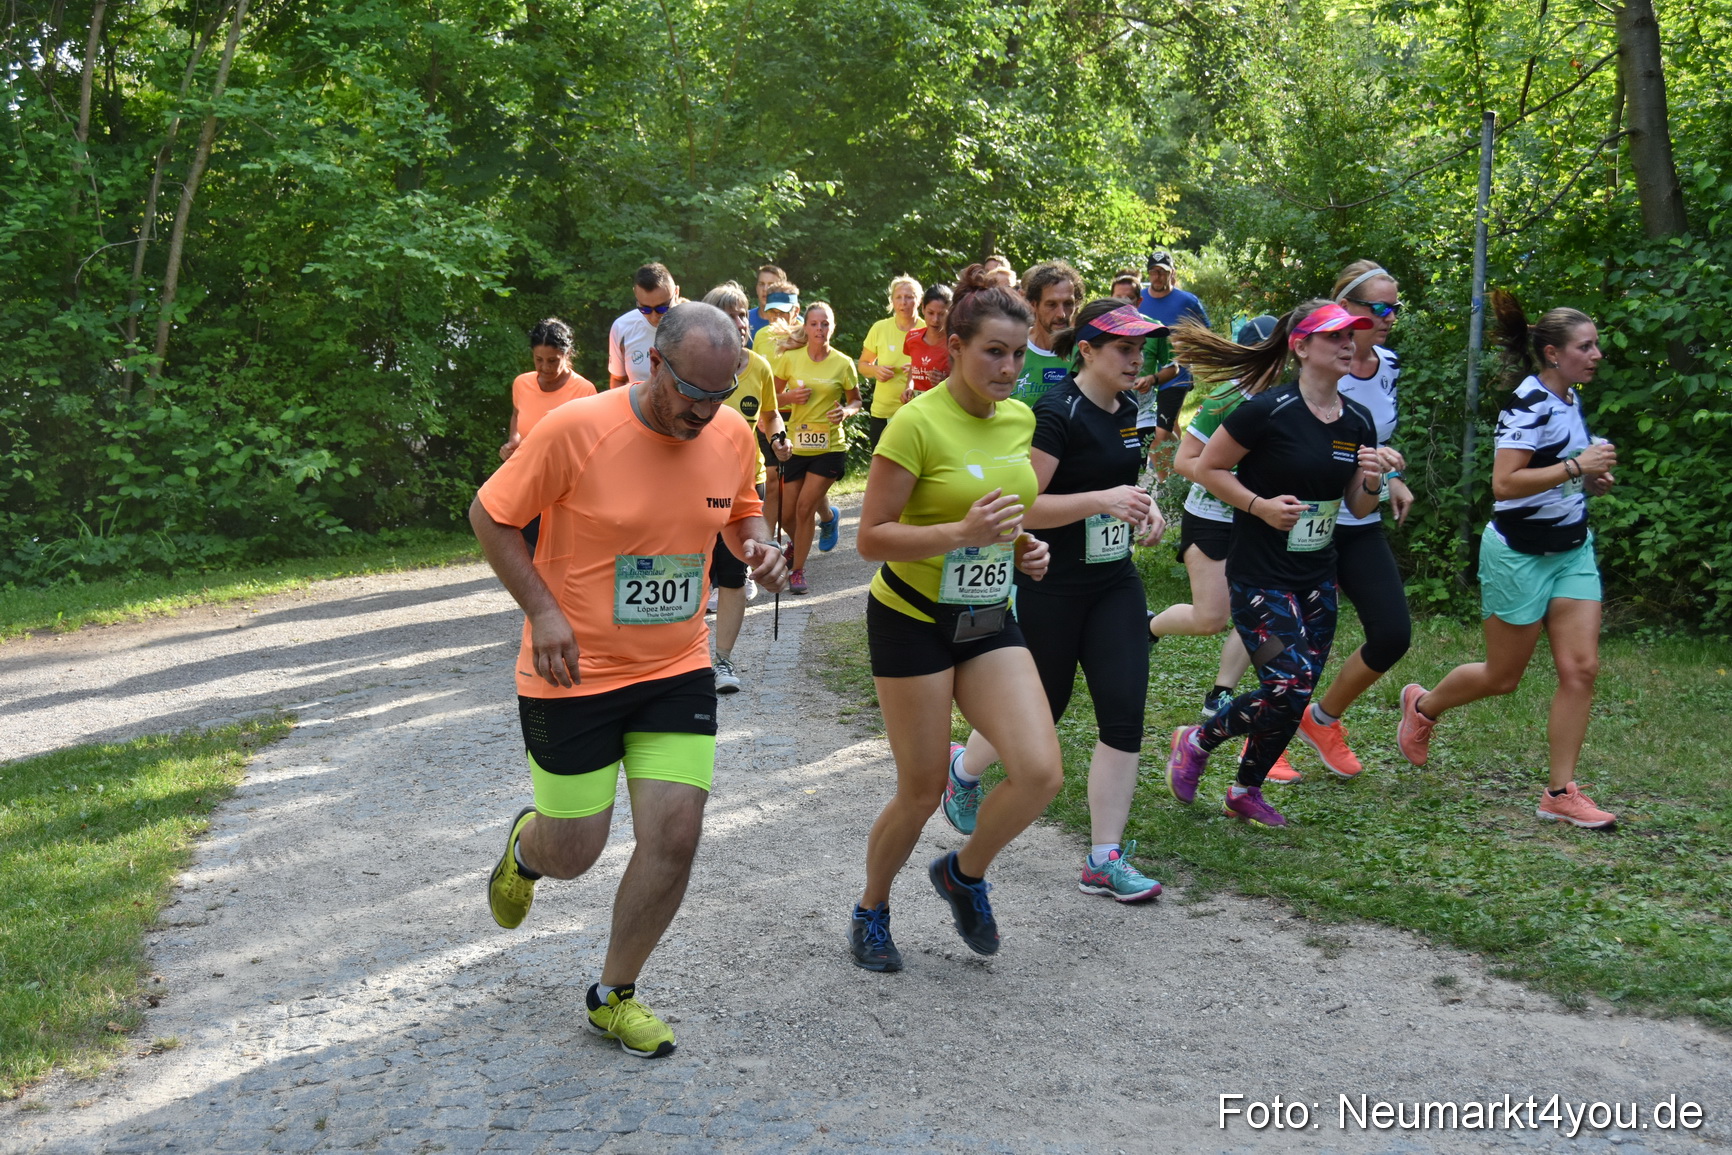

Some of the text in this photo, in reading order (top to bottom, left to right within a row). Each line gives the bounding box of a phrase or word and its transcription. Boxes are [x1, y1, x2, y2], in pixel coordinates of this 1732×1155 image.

[797, 432, 826, 444] 1305
[706, 497, 731, 509] THULE
[1101, 523, 1125, 547] 127
[1305, 517, 1333, 538] 143
[953, 562, 1007, 587] 1265
[625, 578, 690, 605] 2301
[637, 605, 658, 613] López
